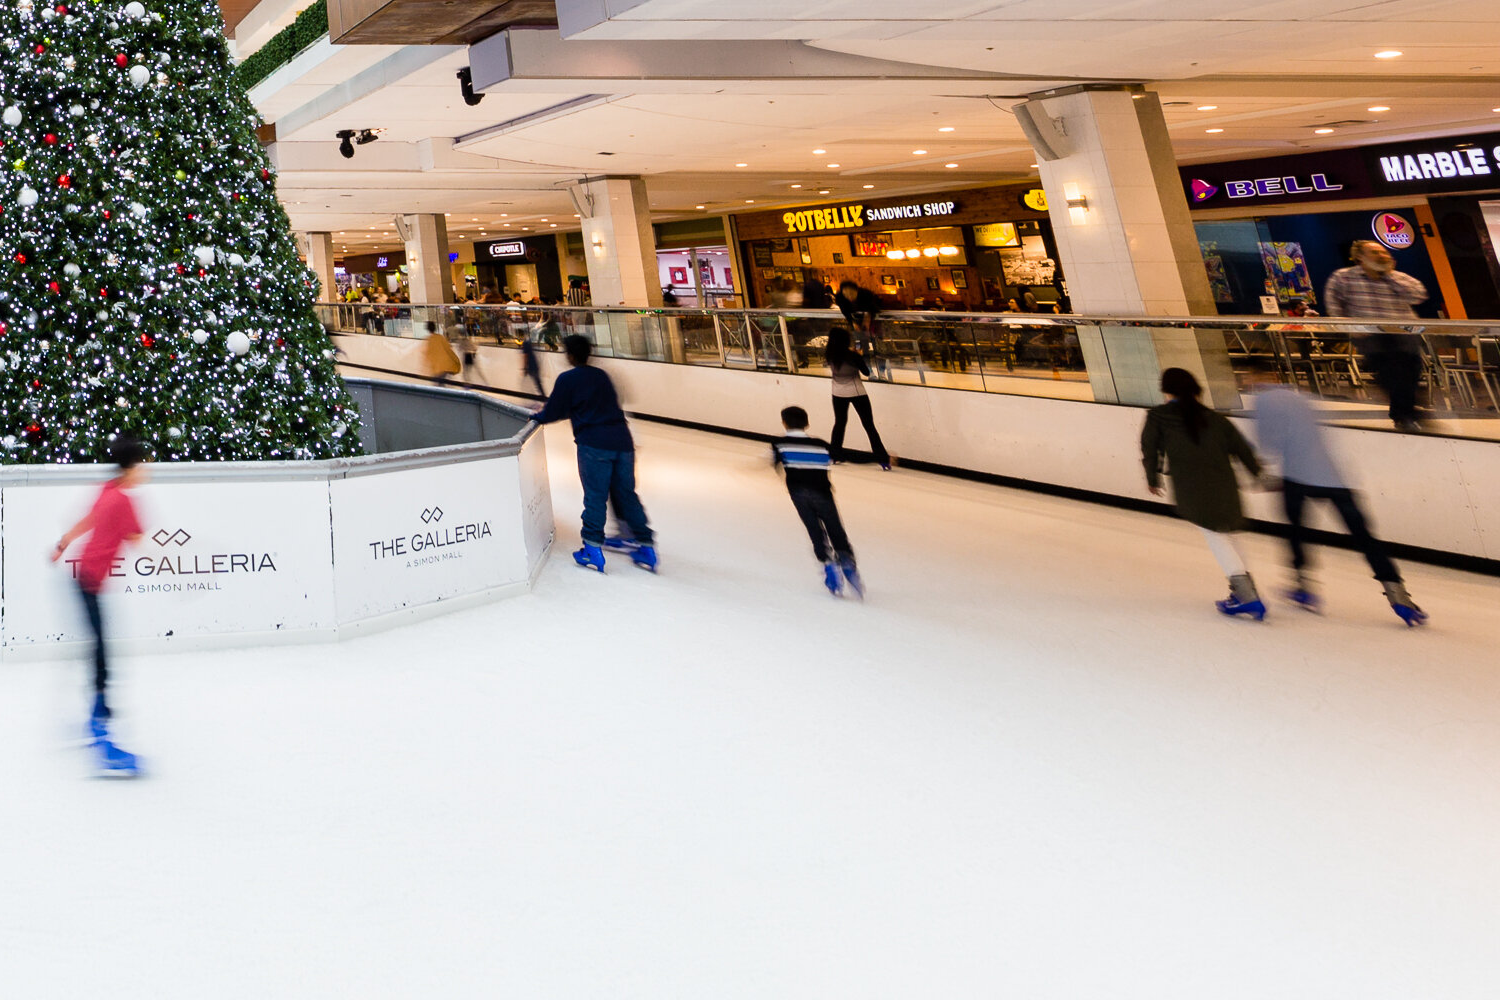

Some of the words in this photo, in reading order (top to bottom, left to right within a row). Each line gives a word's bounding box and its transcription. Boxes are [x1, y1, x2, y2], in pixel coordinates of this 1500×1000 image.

[1379, 148, 1491, 182] MARBLE
[1224, 173, 1343, 199] BELL
[782, 204, 864, 233] POTBELLY
[866, 205, 922, 221] SANDWICH
[923, 201, 955, 216] SHOP
[369, 537, 407, 560] THE
[411, 521, 492, 552] GALLERIA
[64, 556, 127, 579] TE
[134, 553, 277, 577] GALLERIA
[413, 555, 440, 567] SIMON
[441, 551, 463, 561] MALL
[124, 585, 133, 593] A
[137, 583, 182, 593] SIMON
[187, 581, 222, 591] MALL
